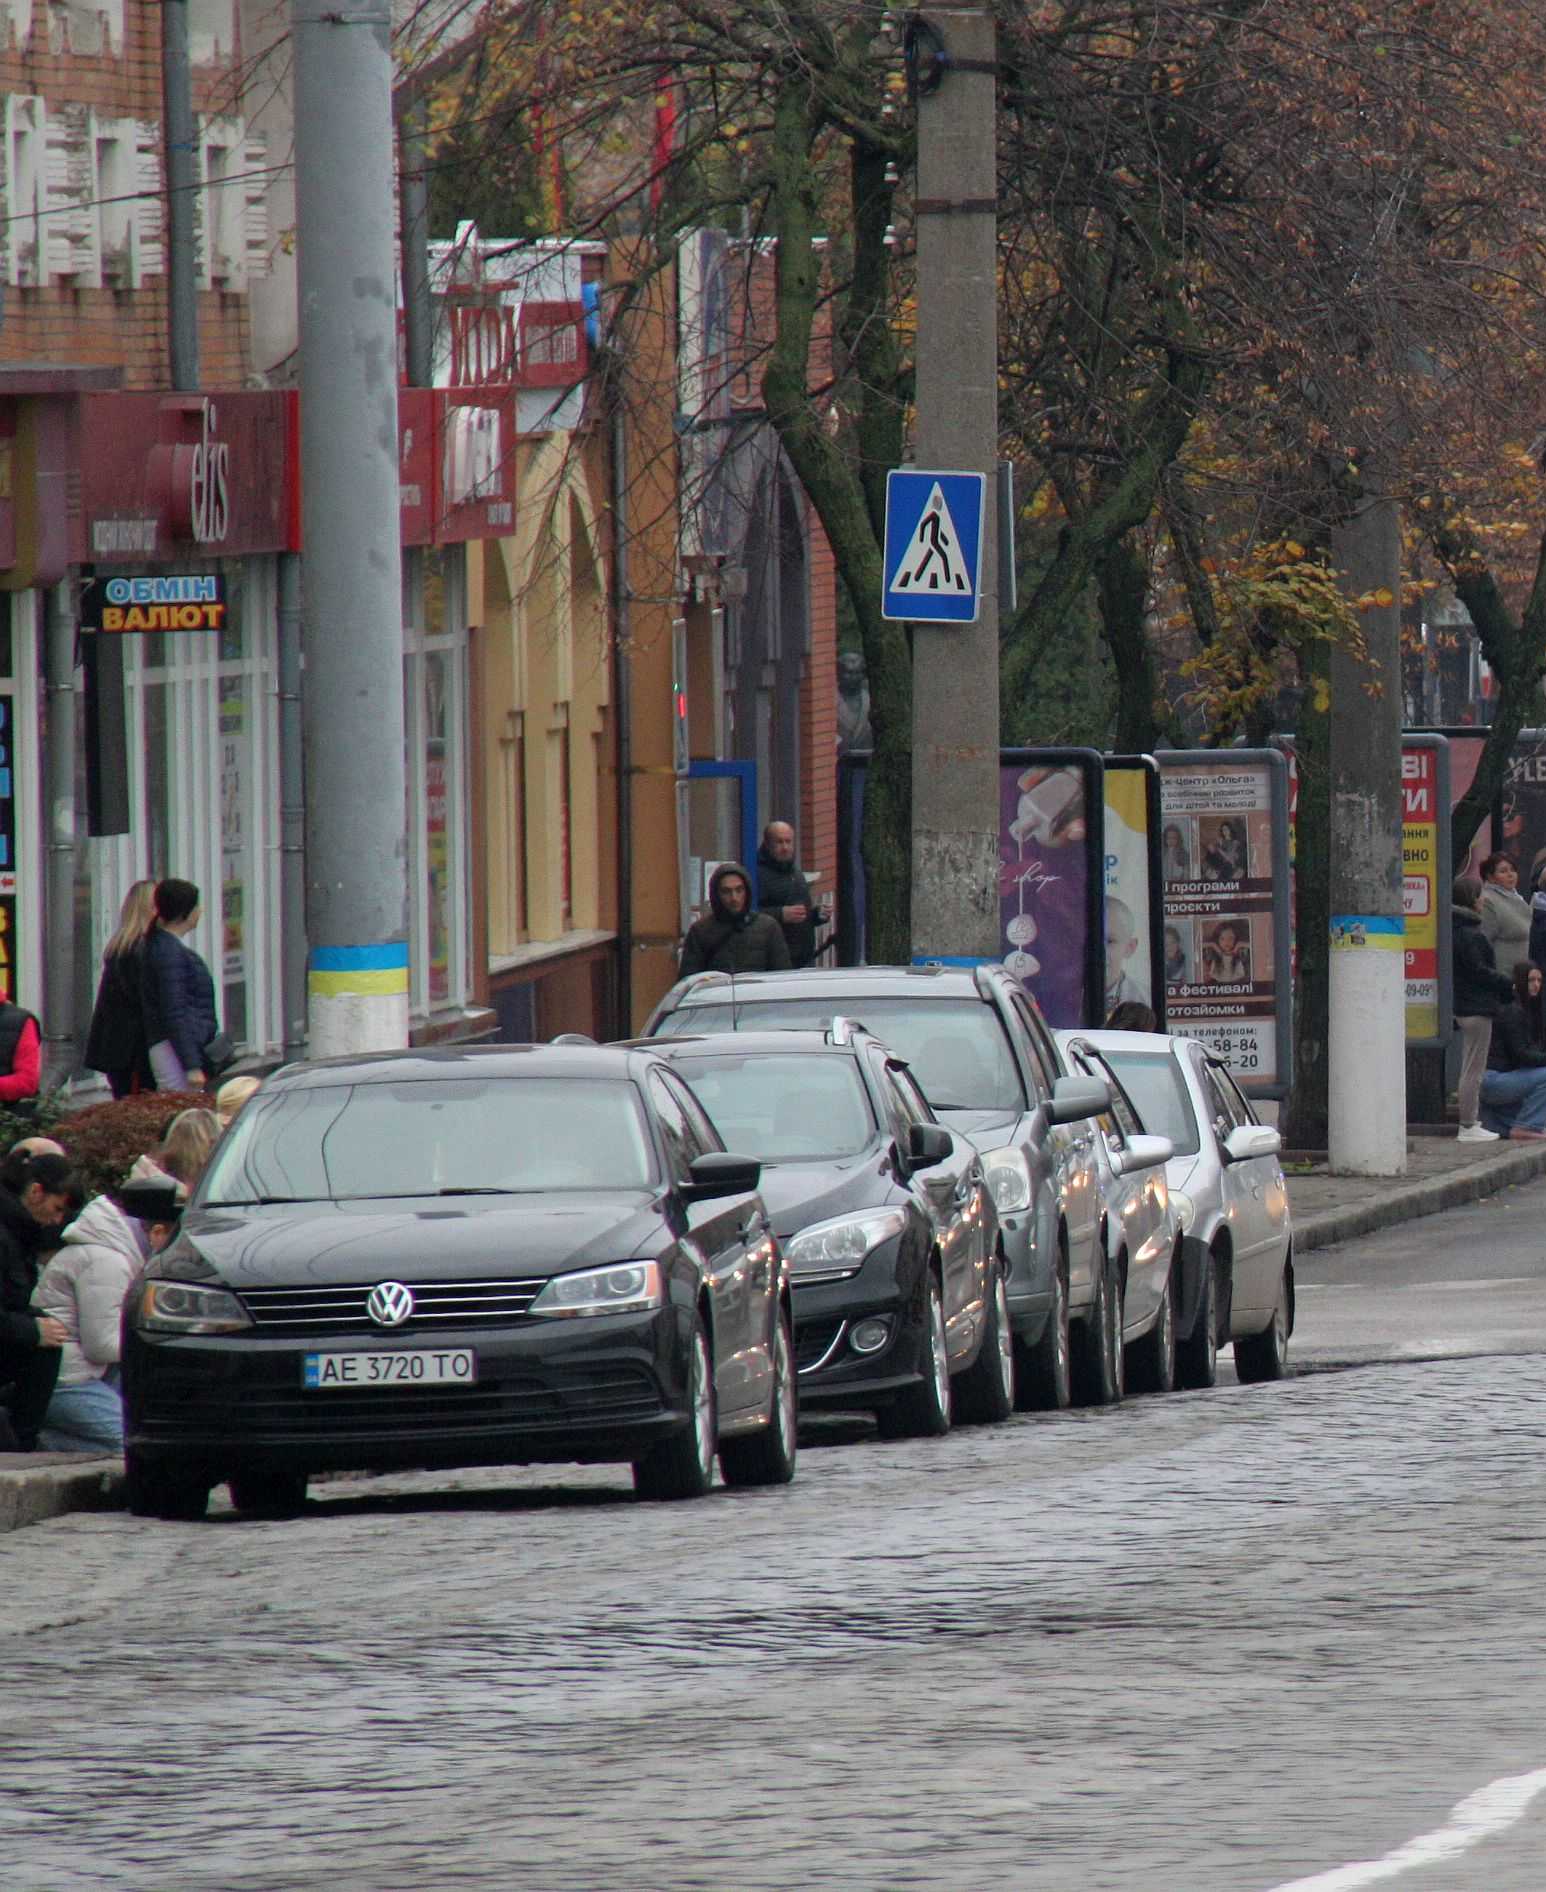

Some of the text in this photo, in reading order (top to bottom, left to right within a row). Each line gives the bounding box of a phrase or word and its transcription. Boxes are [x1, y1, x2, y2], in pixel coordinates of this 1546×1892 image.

[106, 576, 217, 604] ОБМІН
[102, 604, 224, 631] ВАЛЮТ
[1172, 880, 1240, 894] програми
[1180, 982, 1254, 997] фестивалі
[1167, 1004, 1245, 1016] отозйомки
[322, 1353, 470, 1382] AE 3720 TO
